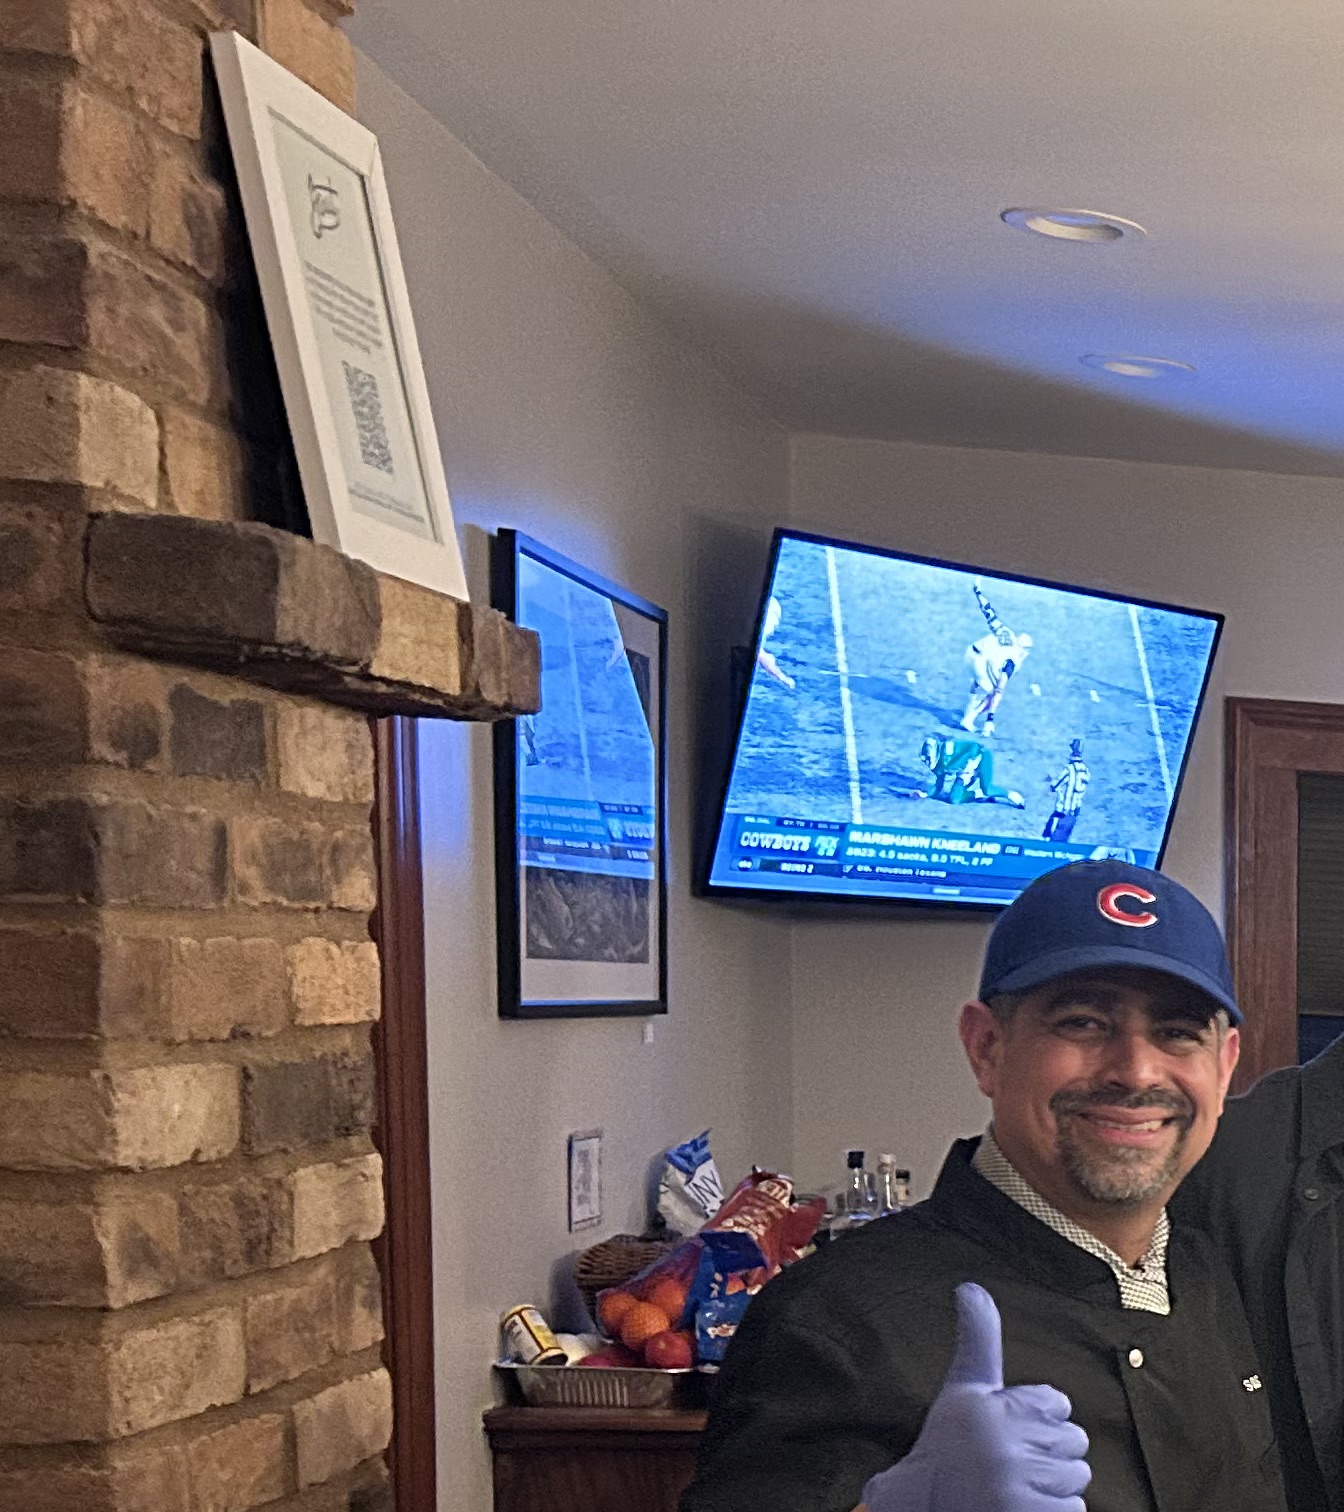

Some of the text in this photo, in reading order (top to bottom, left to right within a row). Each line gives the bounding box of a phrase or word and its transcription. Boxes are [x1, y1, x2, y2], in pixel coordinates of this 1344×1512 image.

[740, 831, 812, 852] COWBOYS
[849, 830, 931, 849] MARSHAWN
[931, 837, 1001, 855] KNEELAND
[1097, 883, 1159, 928] C
